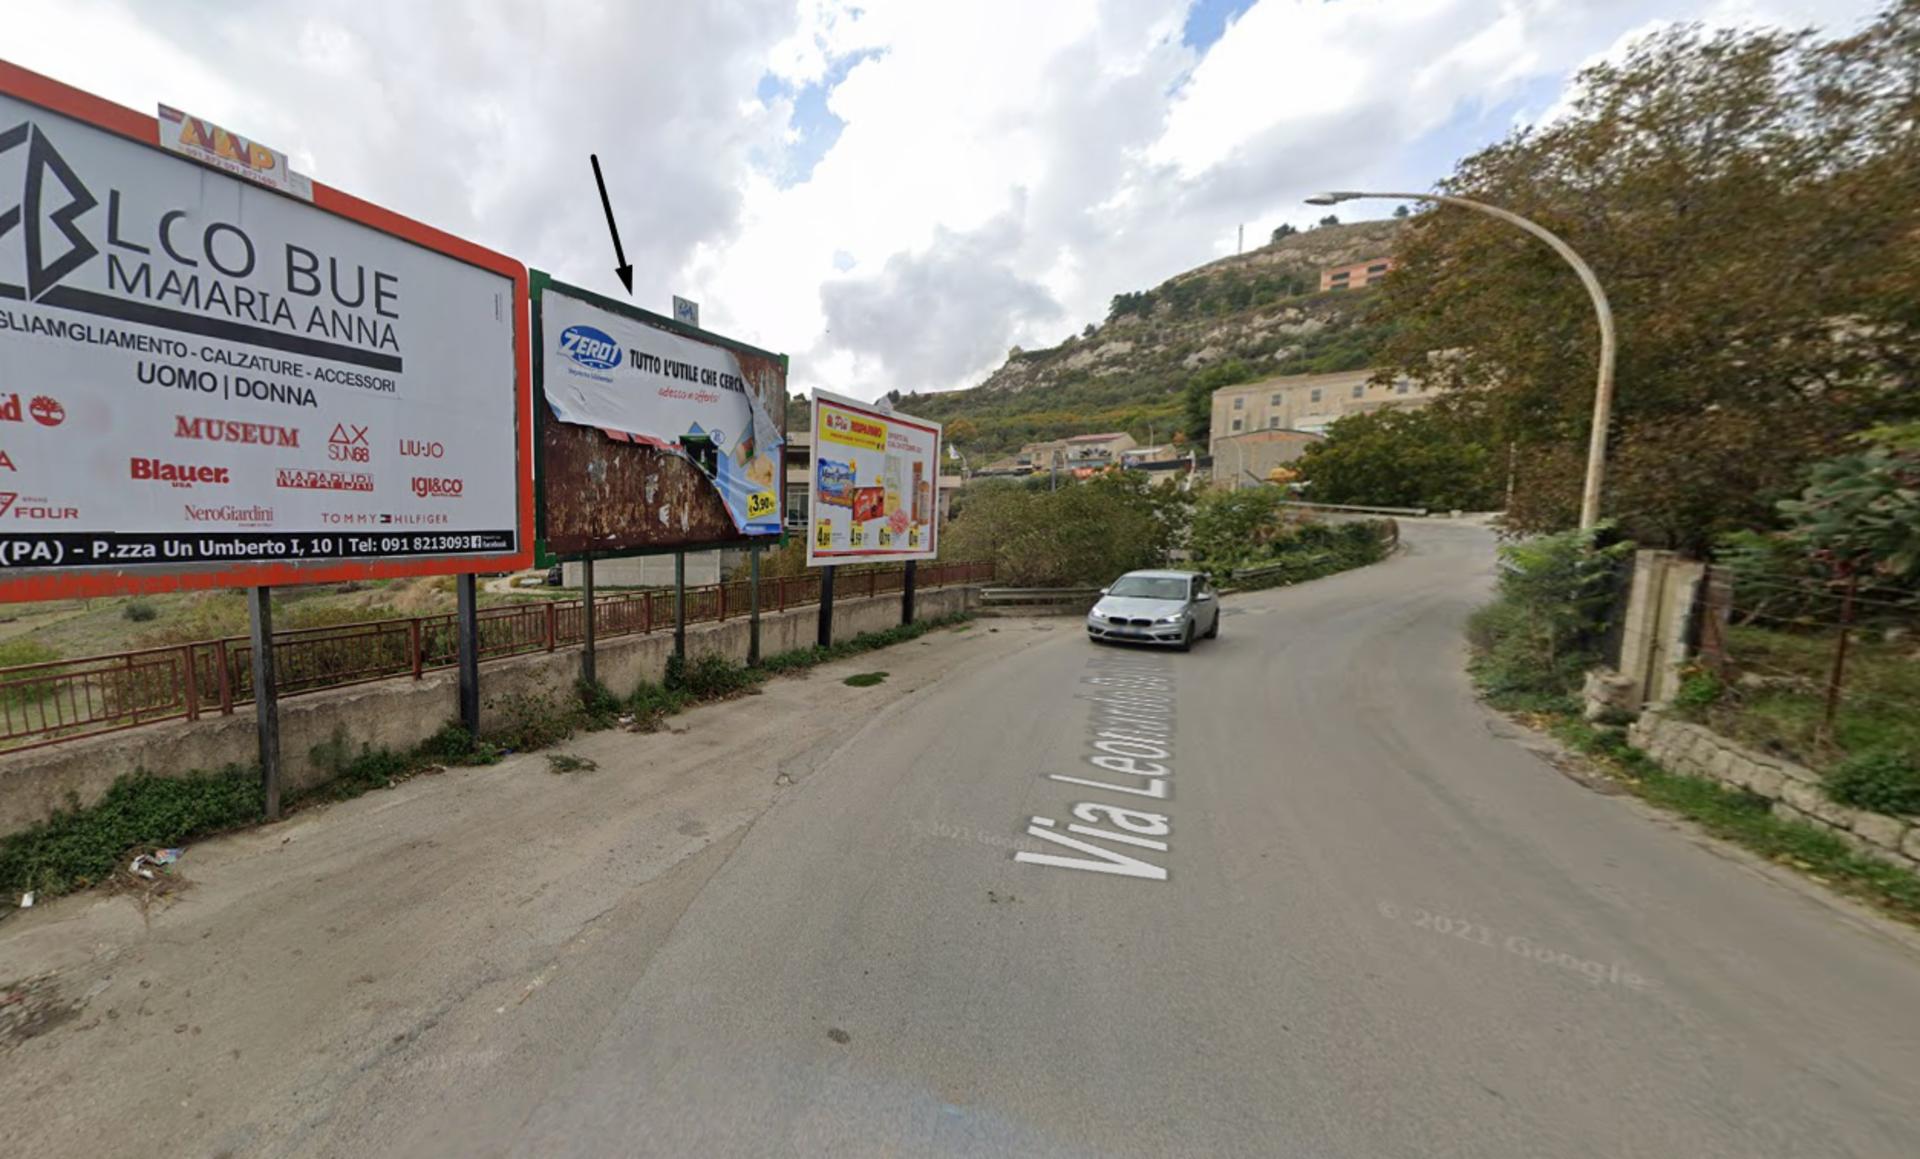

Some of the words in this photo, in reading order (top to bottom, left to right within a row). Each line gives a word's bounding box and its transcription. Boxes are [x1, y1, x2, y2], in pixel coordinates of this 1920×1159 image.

[286, 243, 399, 319] BUE
[306, 305, 400, 352] ANNA
[137, 361, 218, 393] UOMO
[235, 377, 318, 408] DONNA
[201, 346, 304, 378] CALZATURE
[314, 367, 395, 393] ACCESSORI
[629, 349, 661, 374] TUTTO
[664, 358, 699, 383] L'UTILE
[701, 368, 718, 388] CHE
[174, 415, 300, 448] MUSEUM
[328, 444, 370, 462] SUN68
[14, 507, 79, 519] FOUR
[185, 504, 274, 522] NeroGiardini
[321, 513, 378, 524] TOMMY
[394, 515, 449, 525] HILFIGER
[0, 540, 64, 566] (PA)
[92, 542, 156, 558] P.zza
[163, 540, 194, 557] Un
[200, 538, 285, 556] Umberto
[311, 538, 332, 553] 10
[348, 537, 377, 552] Tel:
[381, 536, 409, 551] 091
[413, 535, 470, 550] 8213093
